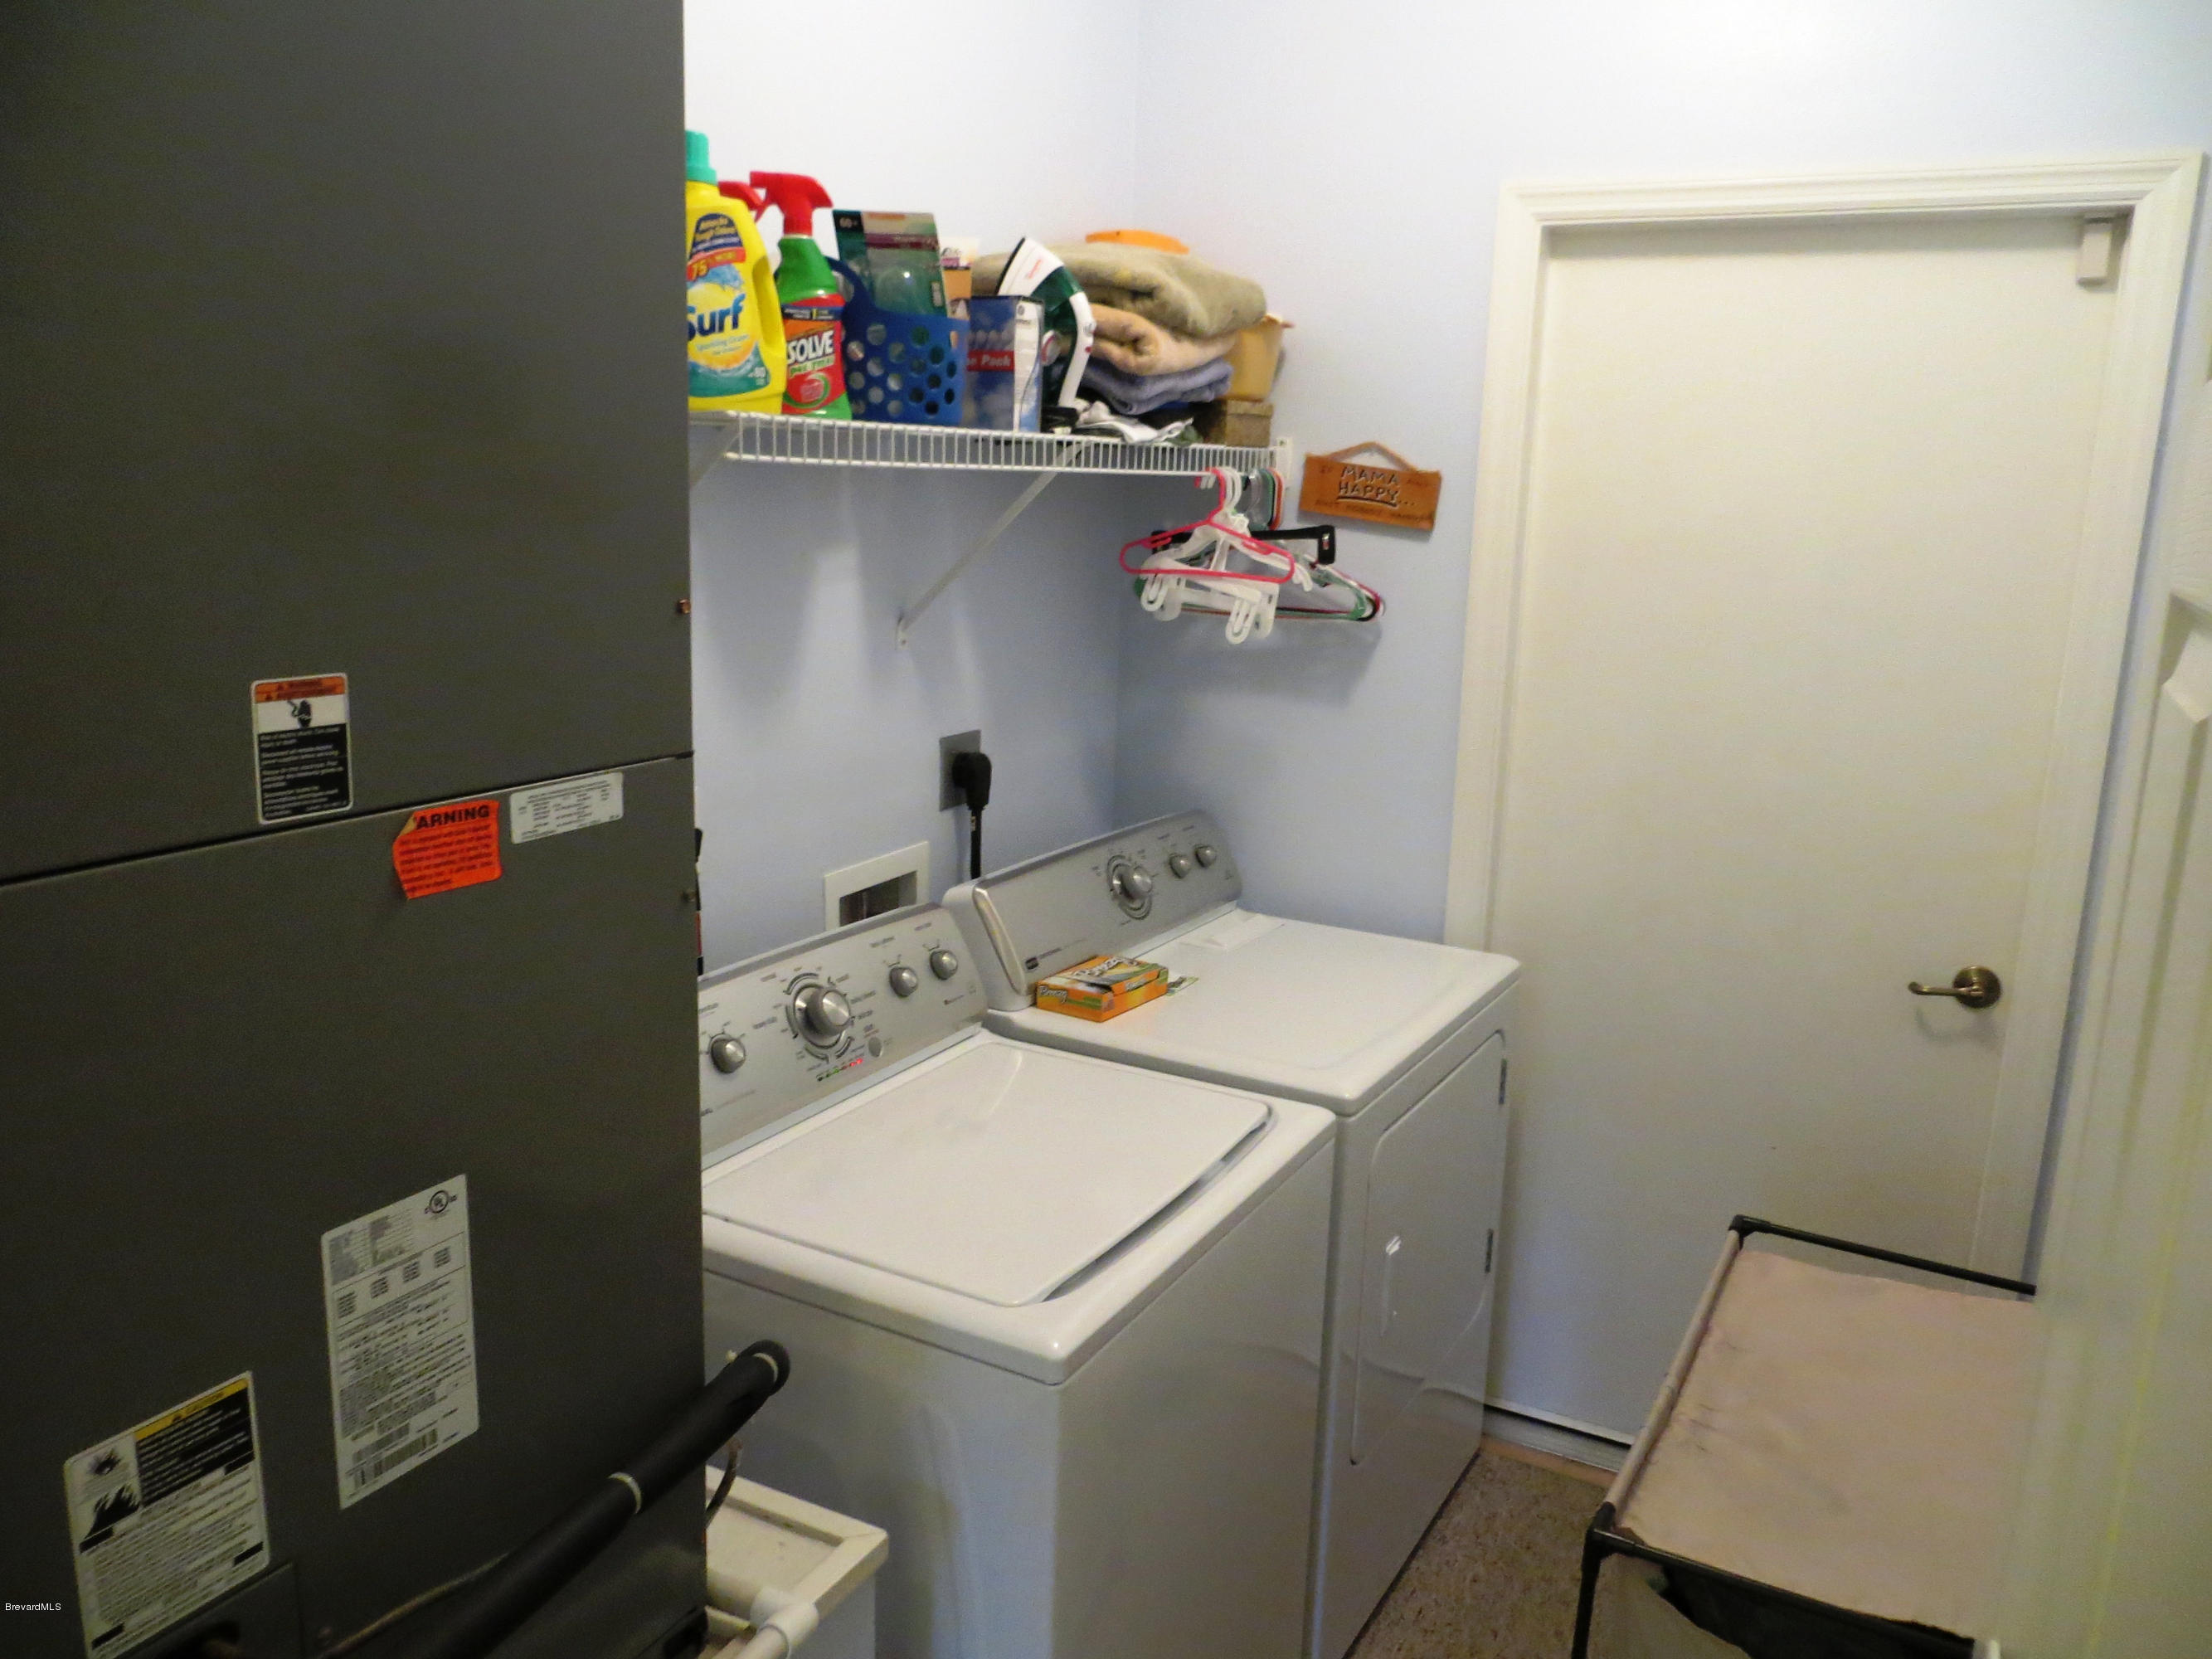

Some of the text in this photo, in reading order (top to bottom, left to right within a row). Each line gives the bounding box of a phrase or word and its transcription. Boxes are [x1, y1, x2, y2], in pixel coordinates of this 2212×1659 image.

[981, 353, 1012, 367] Pack
[1340, 465, 1400, 485] MAMA
[416, 805, 490, 830] ARNING
